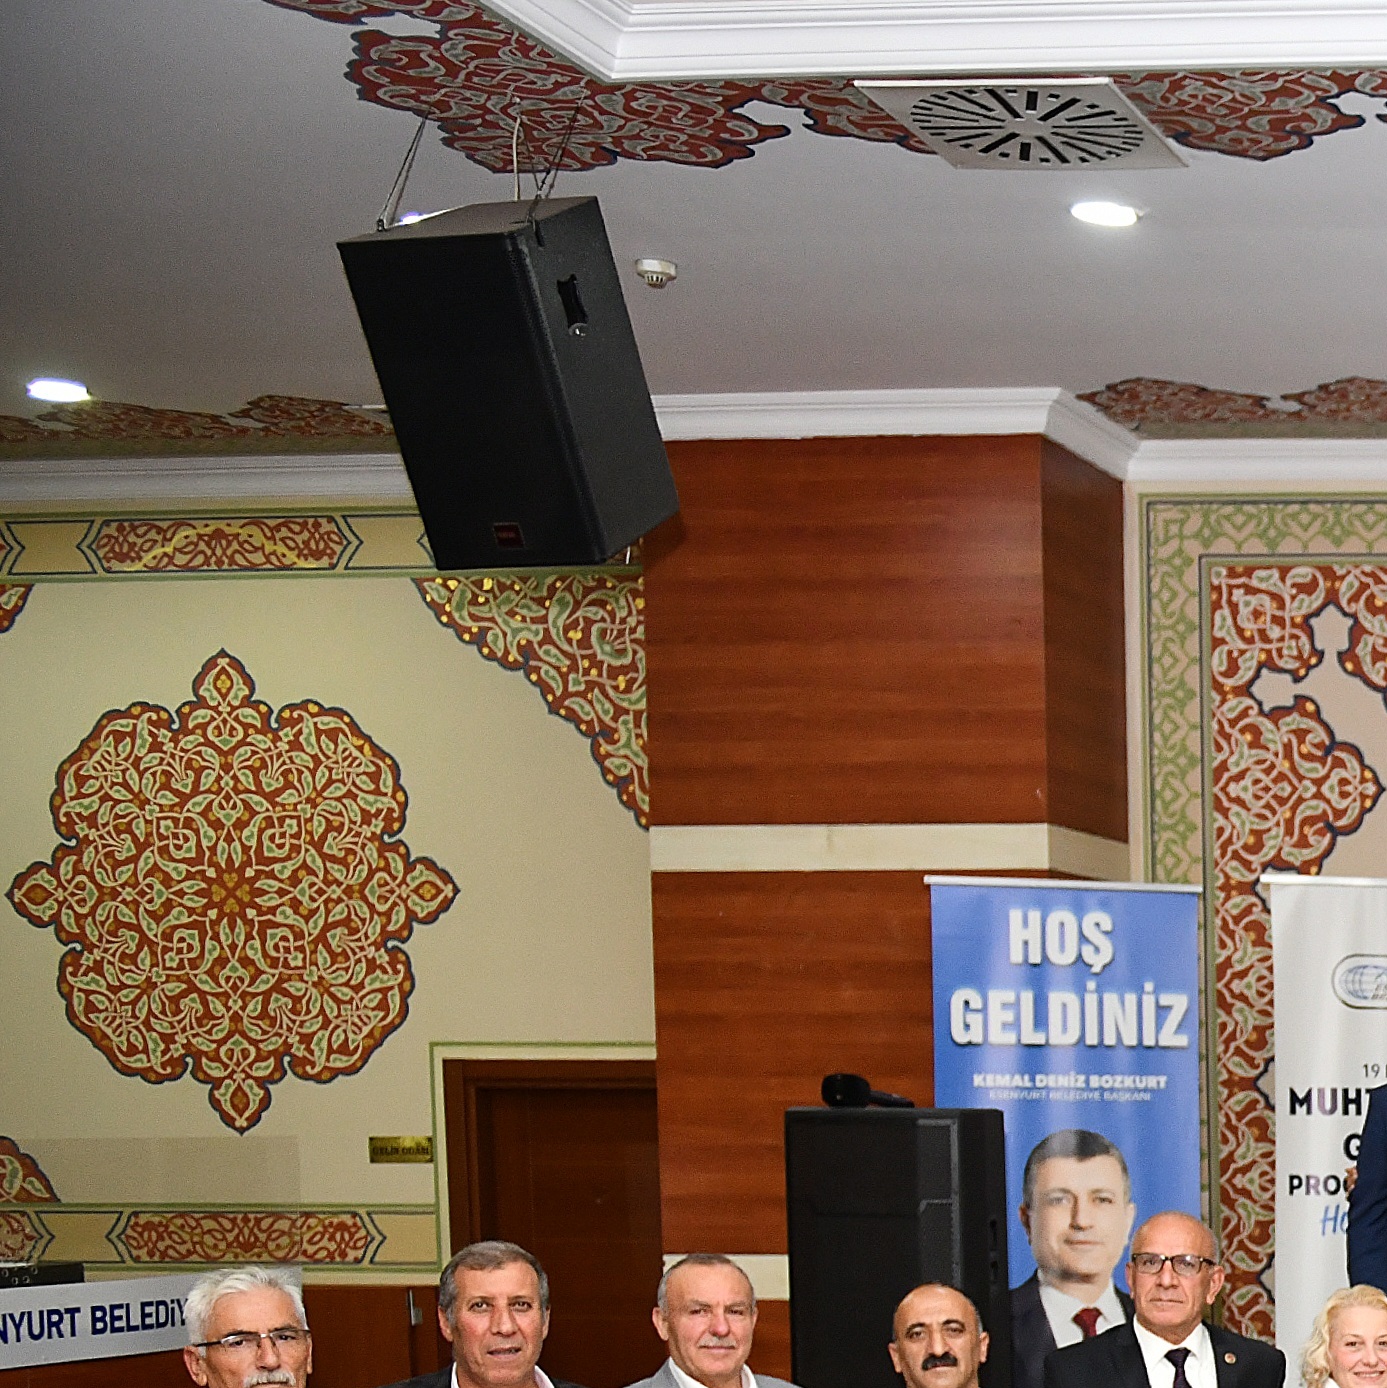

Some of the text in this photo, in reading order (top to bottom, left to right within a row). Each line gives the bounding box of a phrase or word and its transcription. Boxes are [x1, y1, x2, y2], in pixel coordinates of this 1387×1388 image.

[1008, 908, 1114, 974] HOŞ
[950, 980, 1190, 1047] GELDİNİZ
[973, 1070, 1167, 1089] KEMAL DENİZ BOZKURT
[1362, 1064, 1380, 1078] 19
[1289, 1087, 1372, 1116] MUH
[1288, 1175, 1348, 1196] PRO
